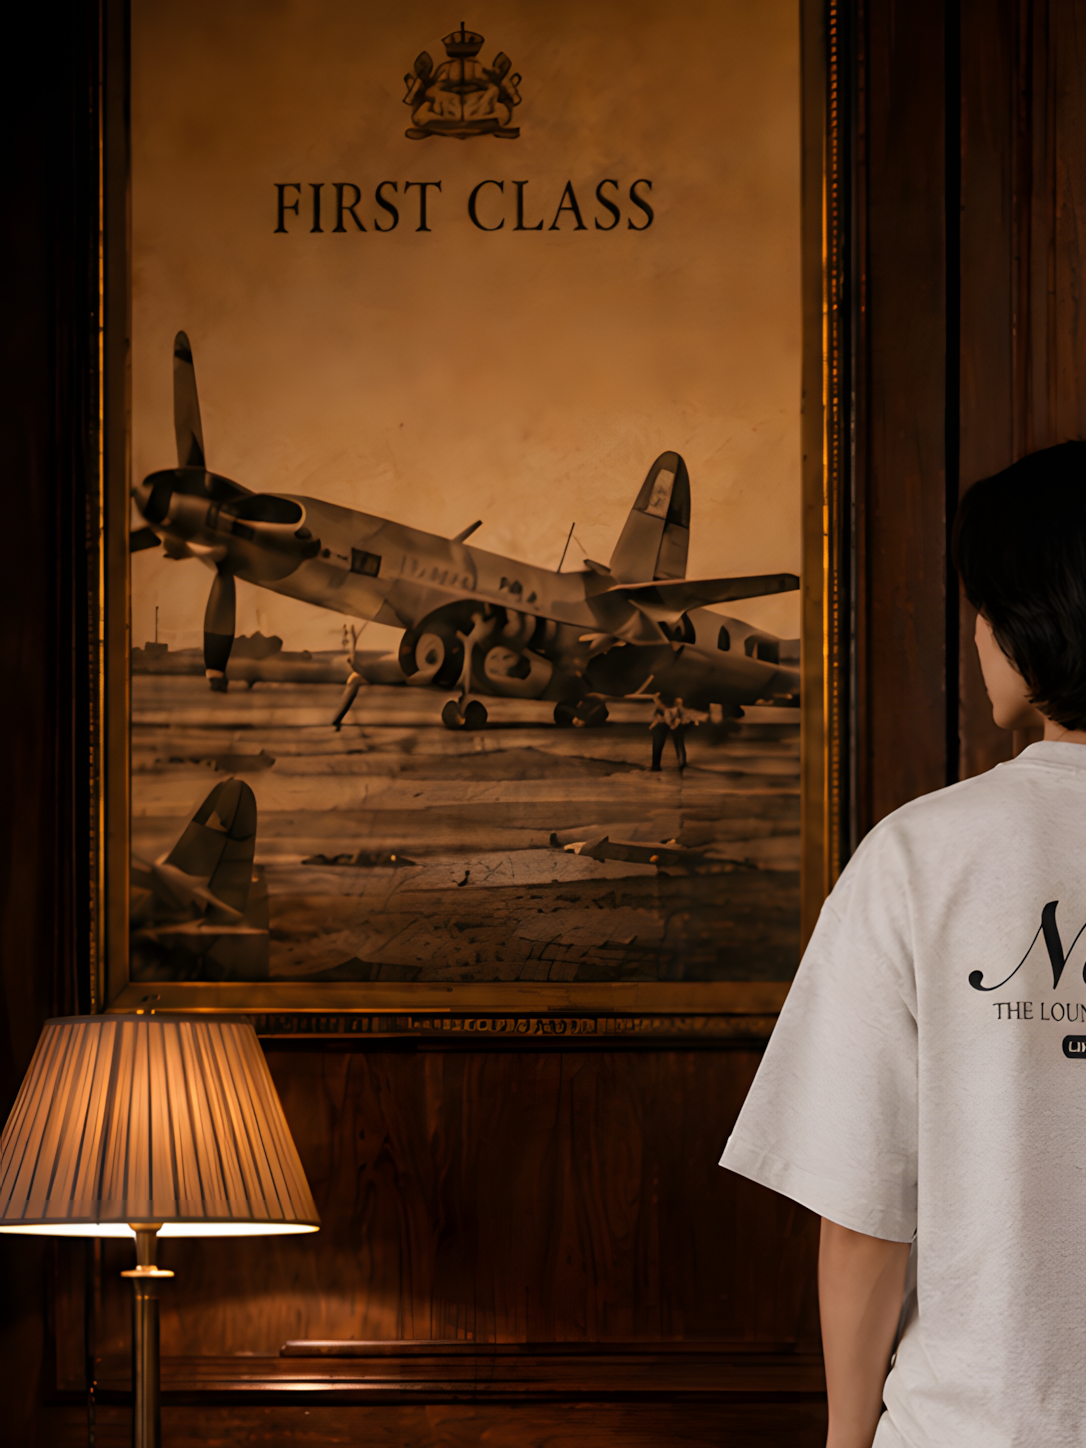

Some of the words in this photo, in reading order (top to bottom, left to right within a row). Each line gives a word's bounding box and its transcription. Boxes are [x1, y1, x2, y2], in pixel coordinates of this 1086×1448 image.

[273, 180, 442, 233] FIRST
[468, 179, 654, 231] CLASS
[993, 1002, 1033, 1020] THE
